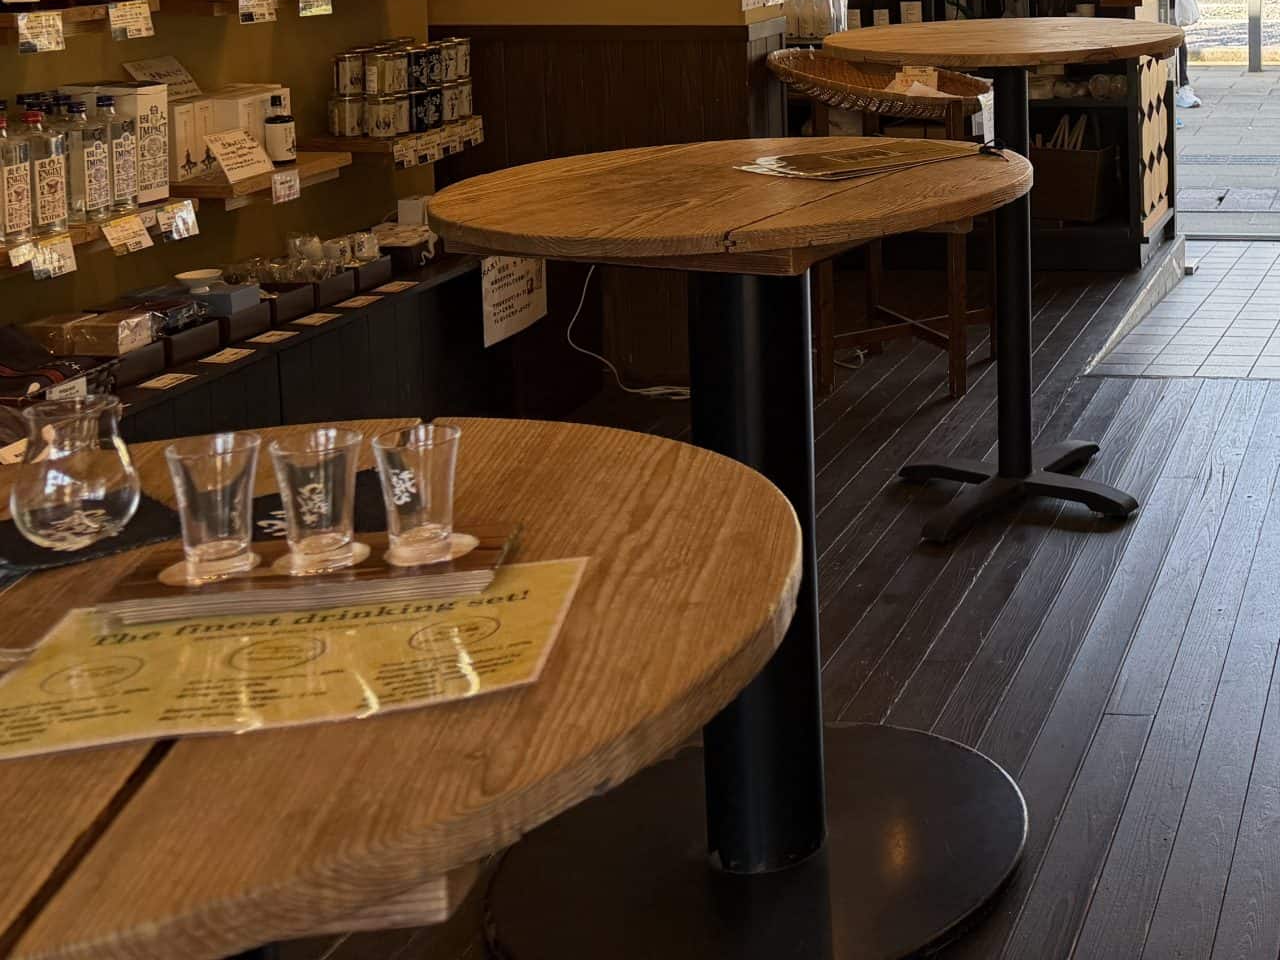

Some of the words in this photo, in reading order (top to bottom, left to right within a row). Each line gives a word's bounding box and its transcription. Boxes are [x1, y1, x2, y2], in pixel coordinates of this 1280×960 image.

[175, 618, 281, 637] finest
[292, 600, 459, 624] drinking
[467, 589, 531, 606] set!
